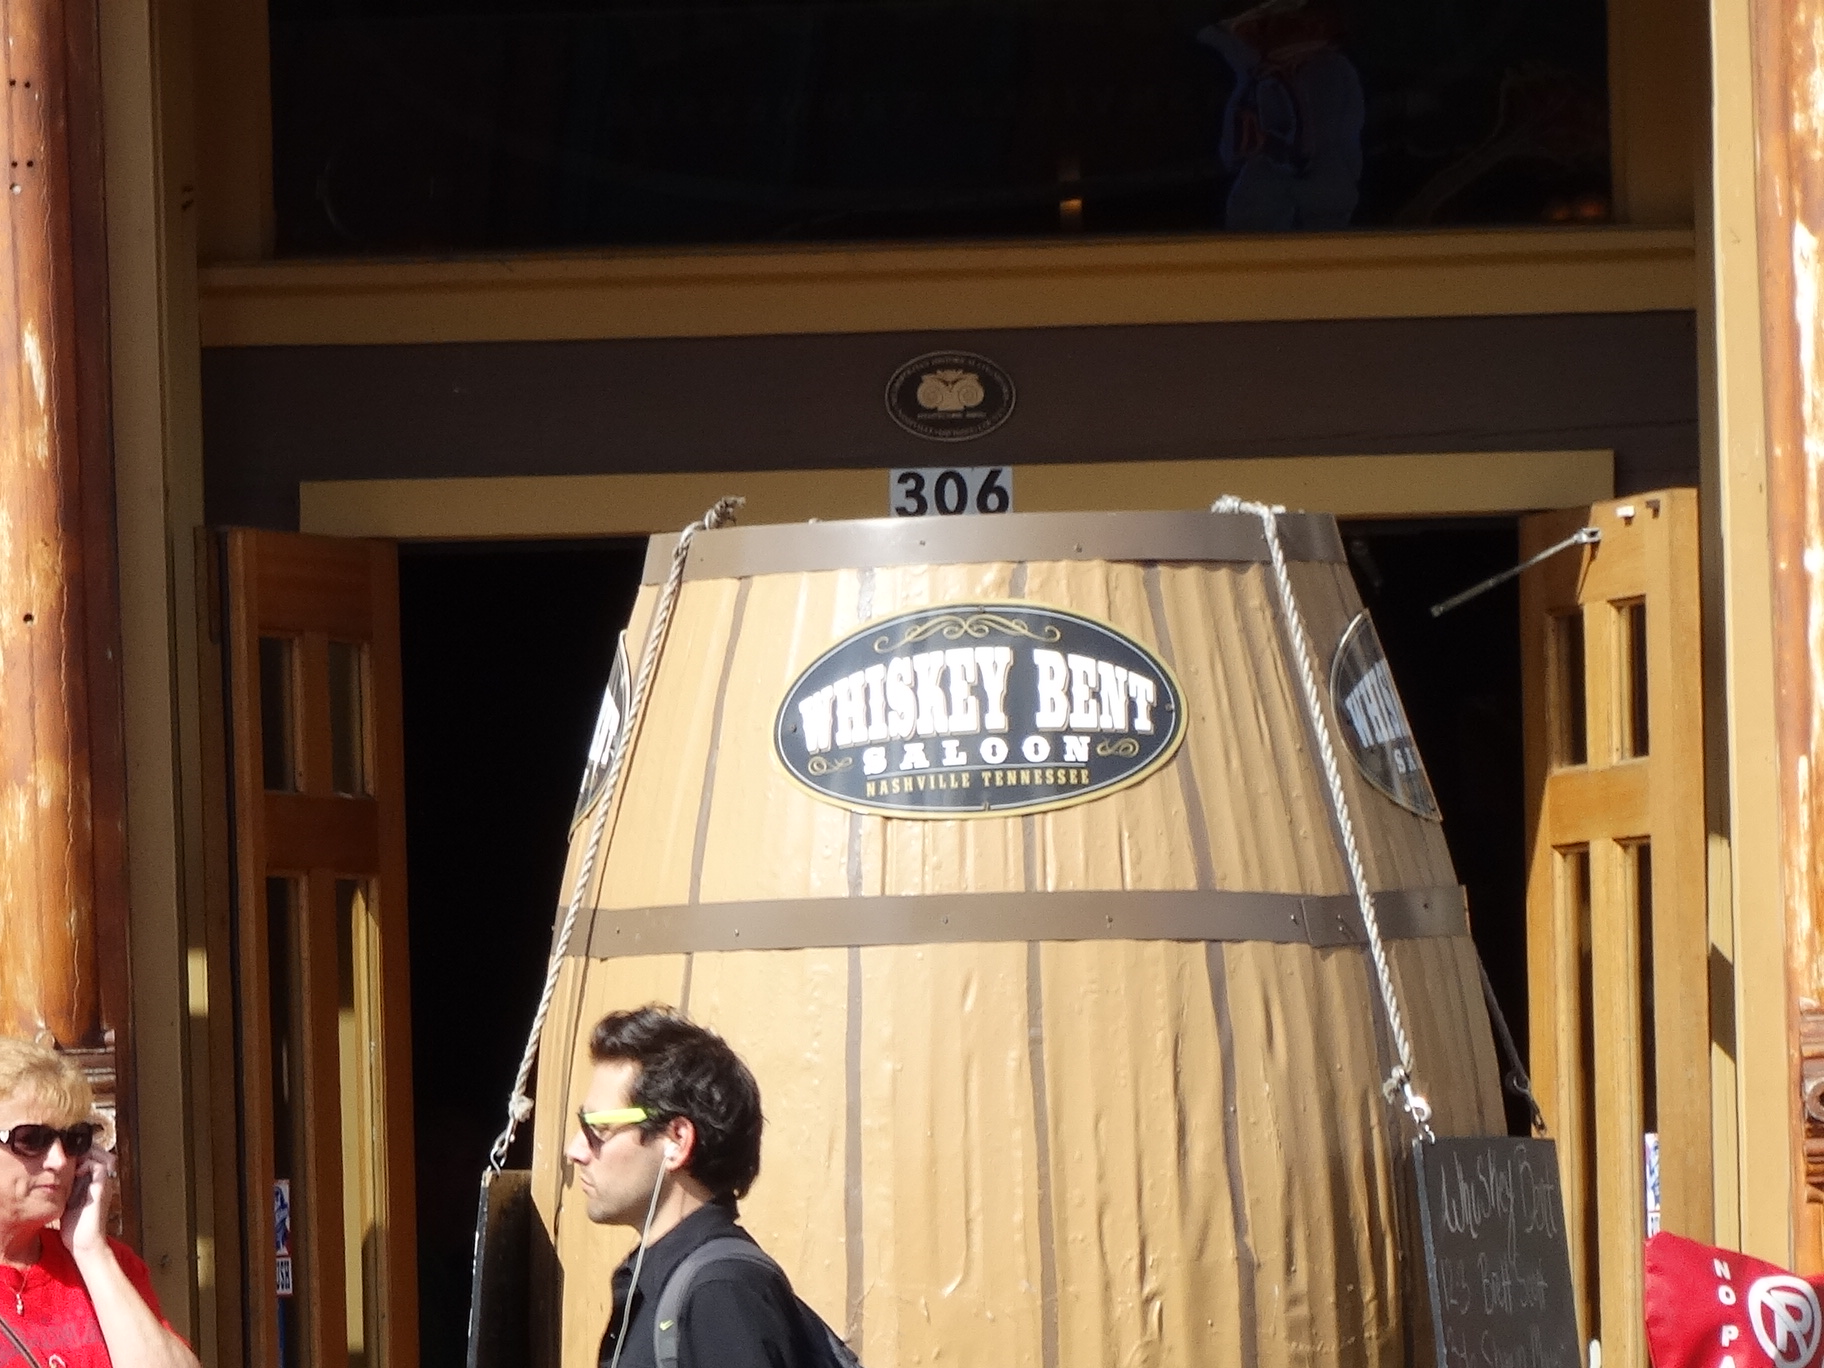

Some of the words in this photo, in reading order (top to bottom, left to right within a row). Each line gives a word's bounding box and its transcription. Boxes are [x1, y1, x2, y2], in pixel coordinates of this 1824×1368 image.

[895, 469, 1009, 517] 306
[798, 646, 1013, 754] WHISKEY
[1033, 648, 1158, 734] BENT
[863, 735, 1090, 775] SALOON
[866, 772, 971, 797] NASHVILLE
[982, 767, 1090, 787] TENNESSEE
[1713, 1258, 1736, 1305] NO
